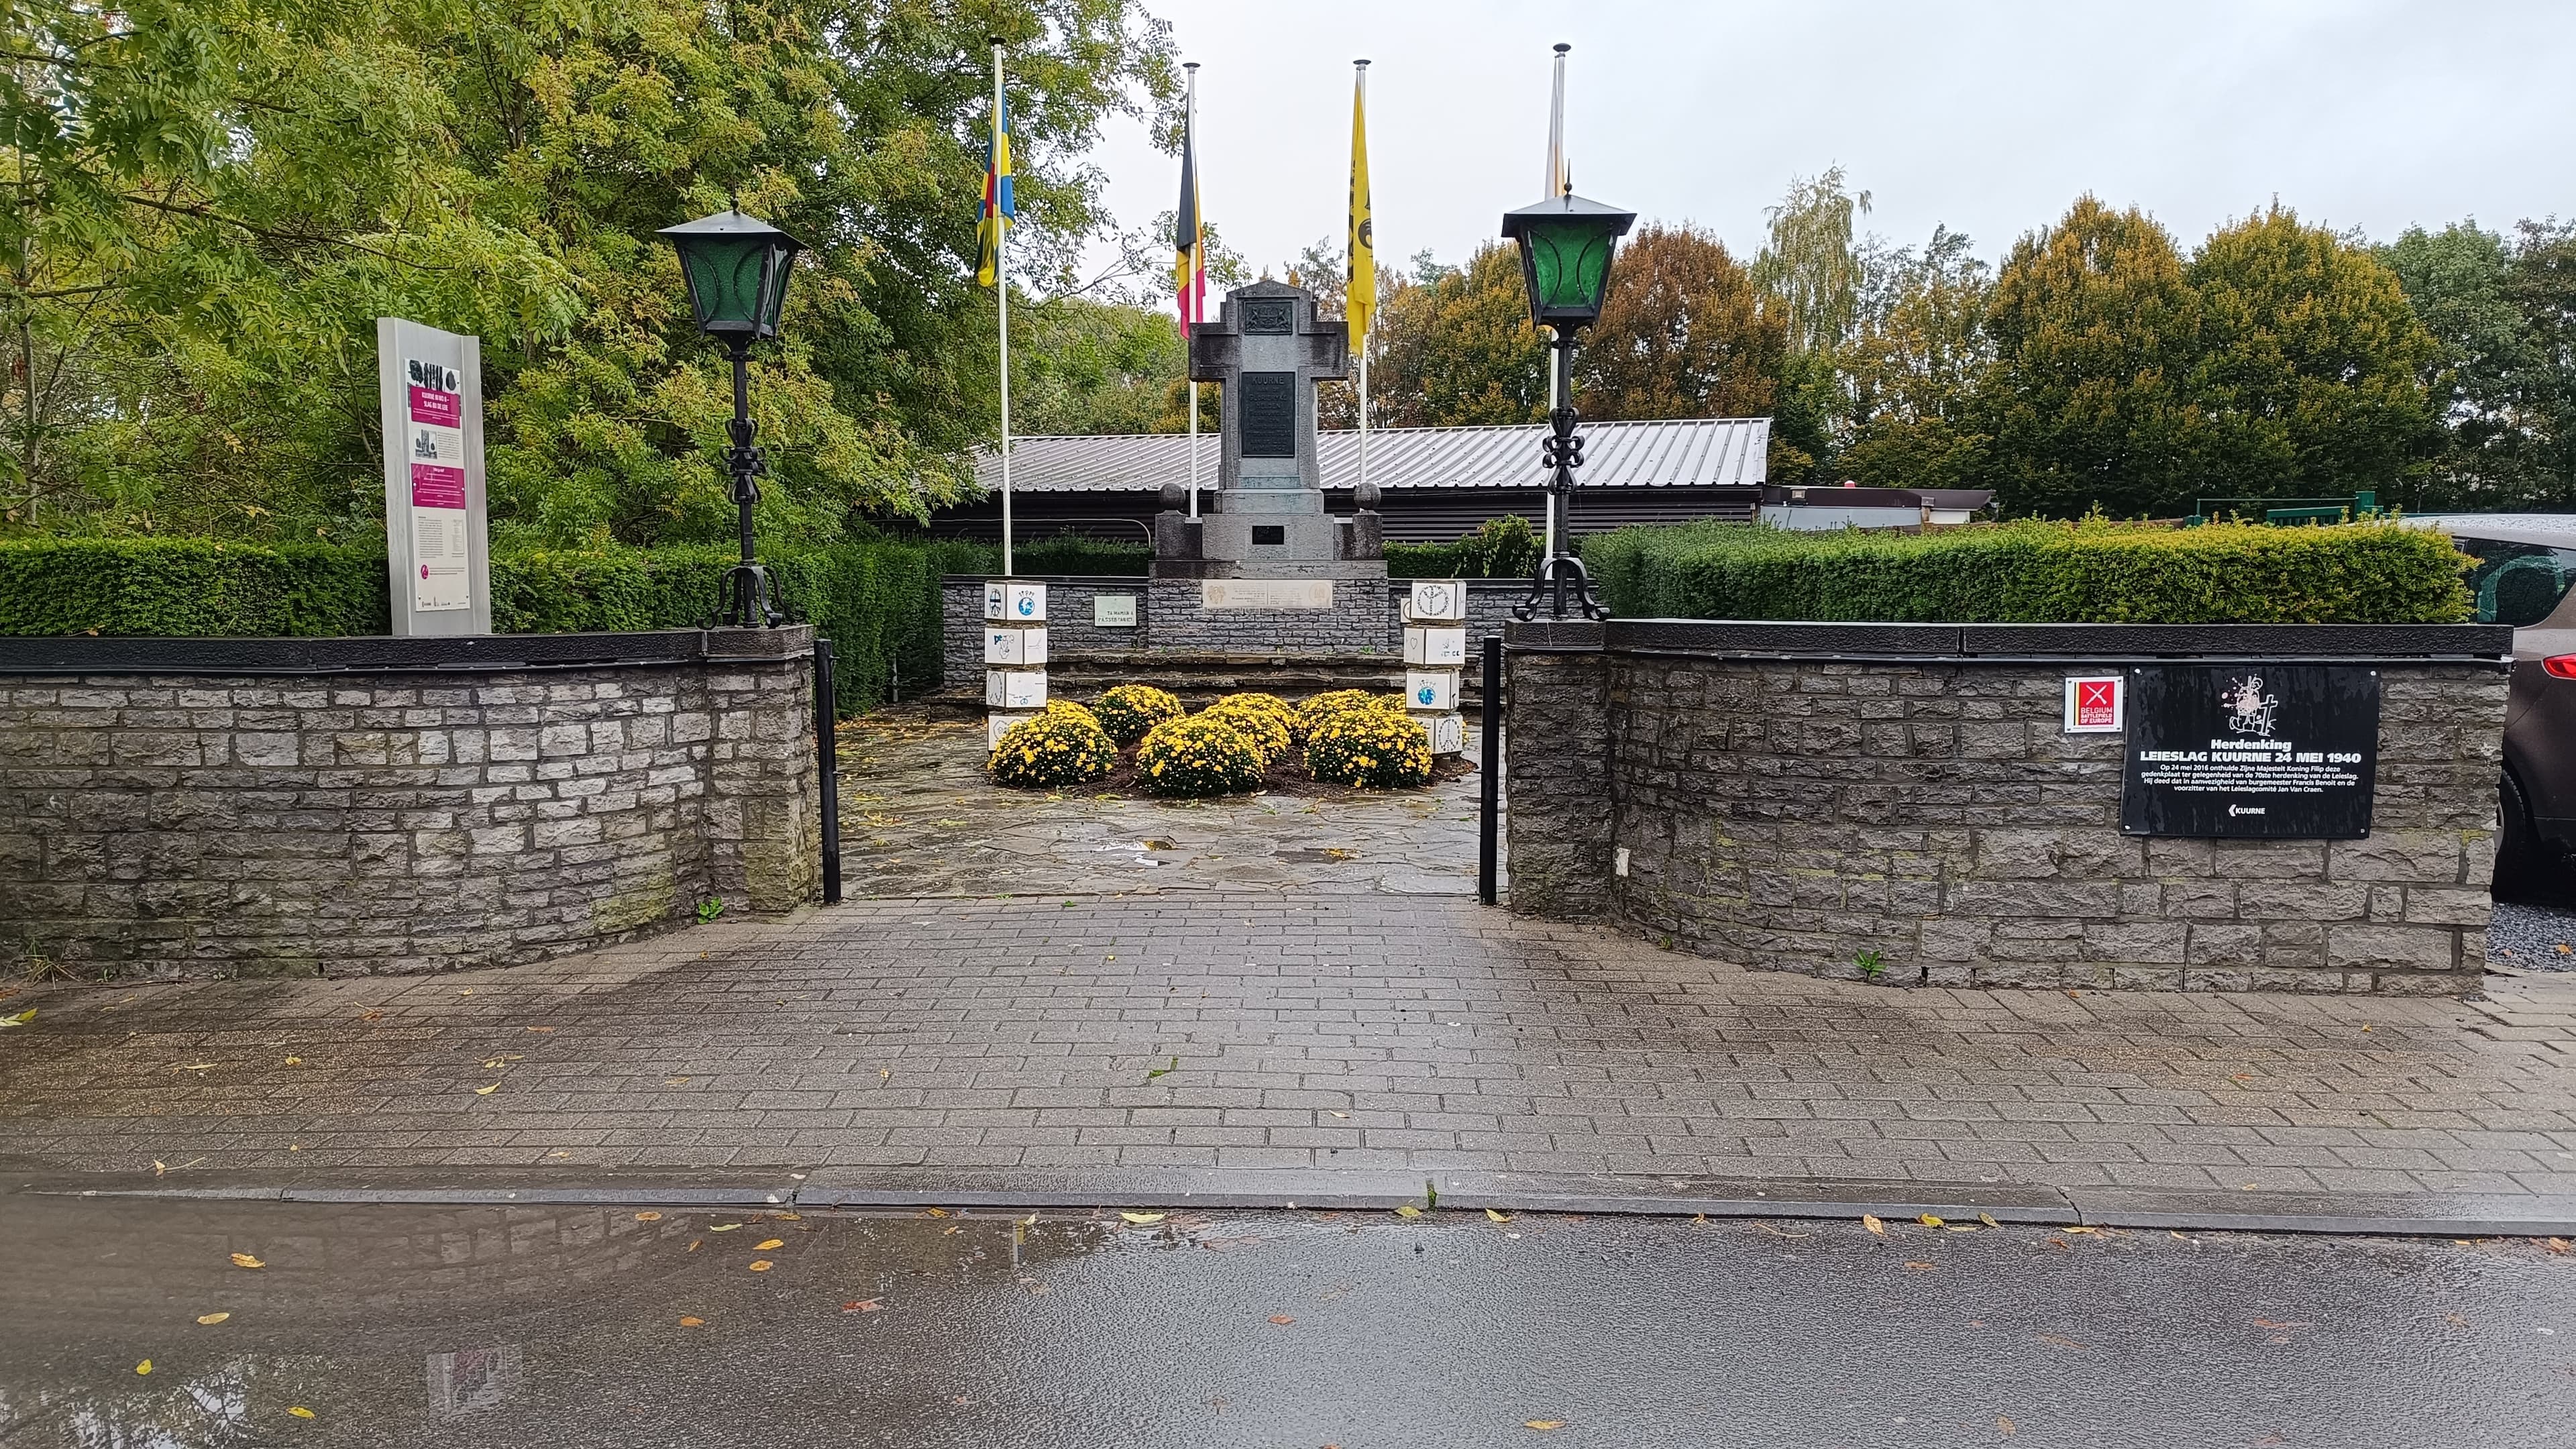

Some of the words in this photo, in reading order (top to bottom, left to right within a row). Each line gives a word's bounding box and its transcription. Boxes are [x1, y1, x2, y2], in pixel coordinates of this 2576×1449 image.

[1252, 376, 1285, 384] KUURNE
[2211, 739, 2292, 753] Herdenking
[2140, 751, 2208, 762] LEIESLAG
[2211, 751, 2272, 763] KUURNE
[2275, 752, 2292, 763] 24
[2296, 753, 2324, 763] MEI
[2326, 753, 2362, 763] 1940
[2239, 765, 2256, 773] Zijne
[2231, 786, 2277, 794] Leieslagcomité
